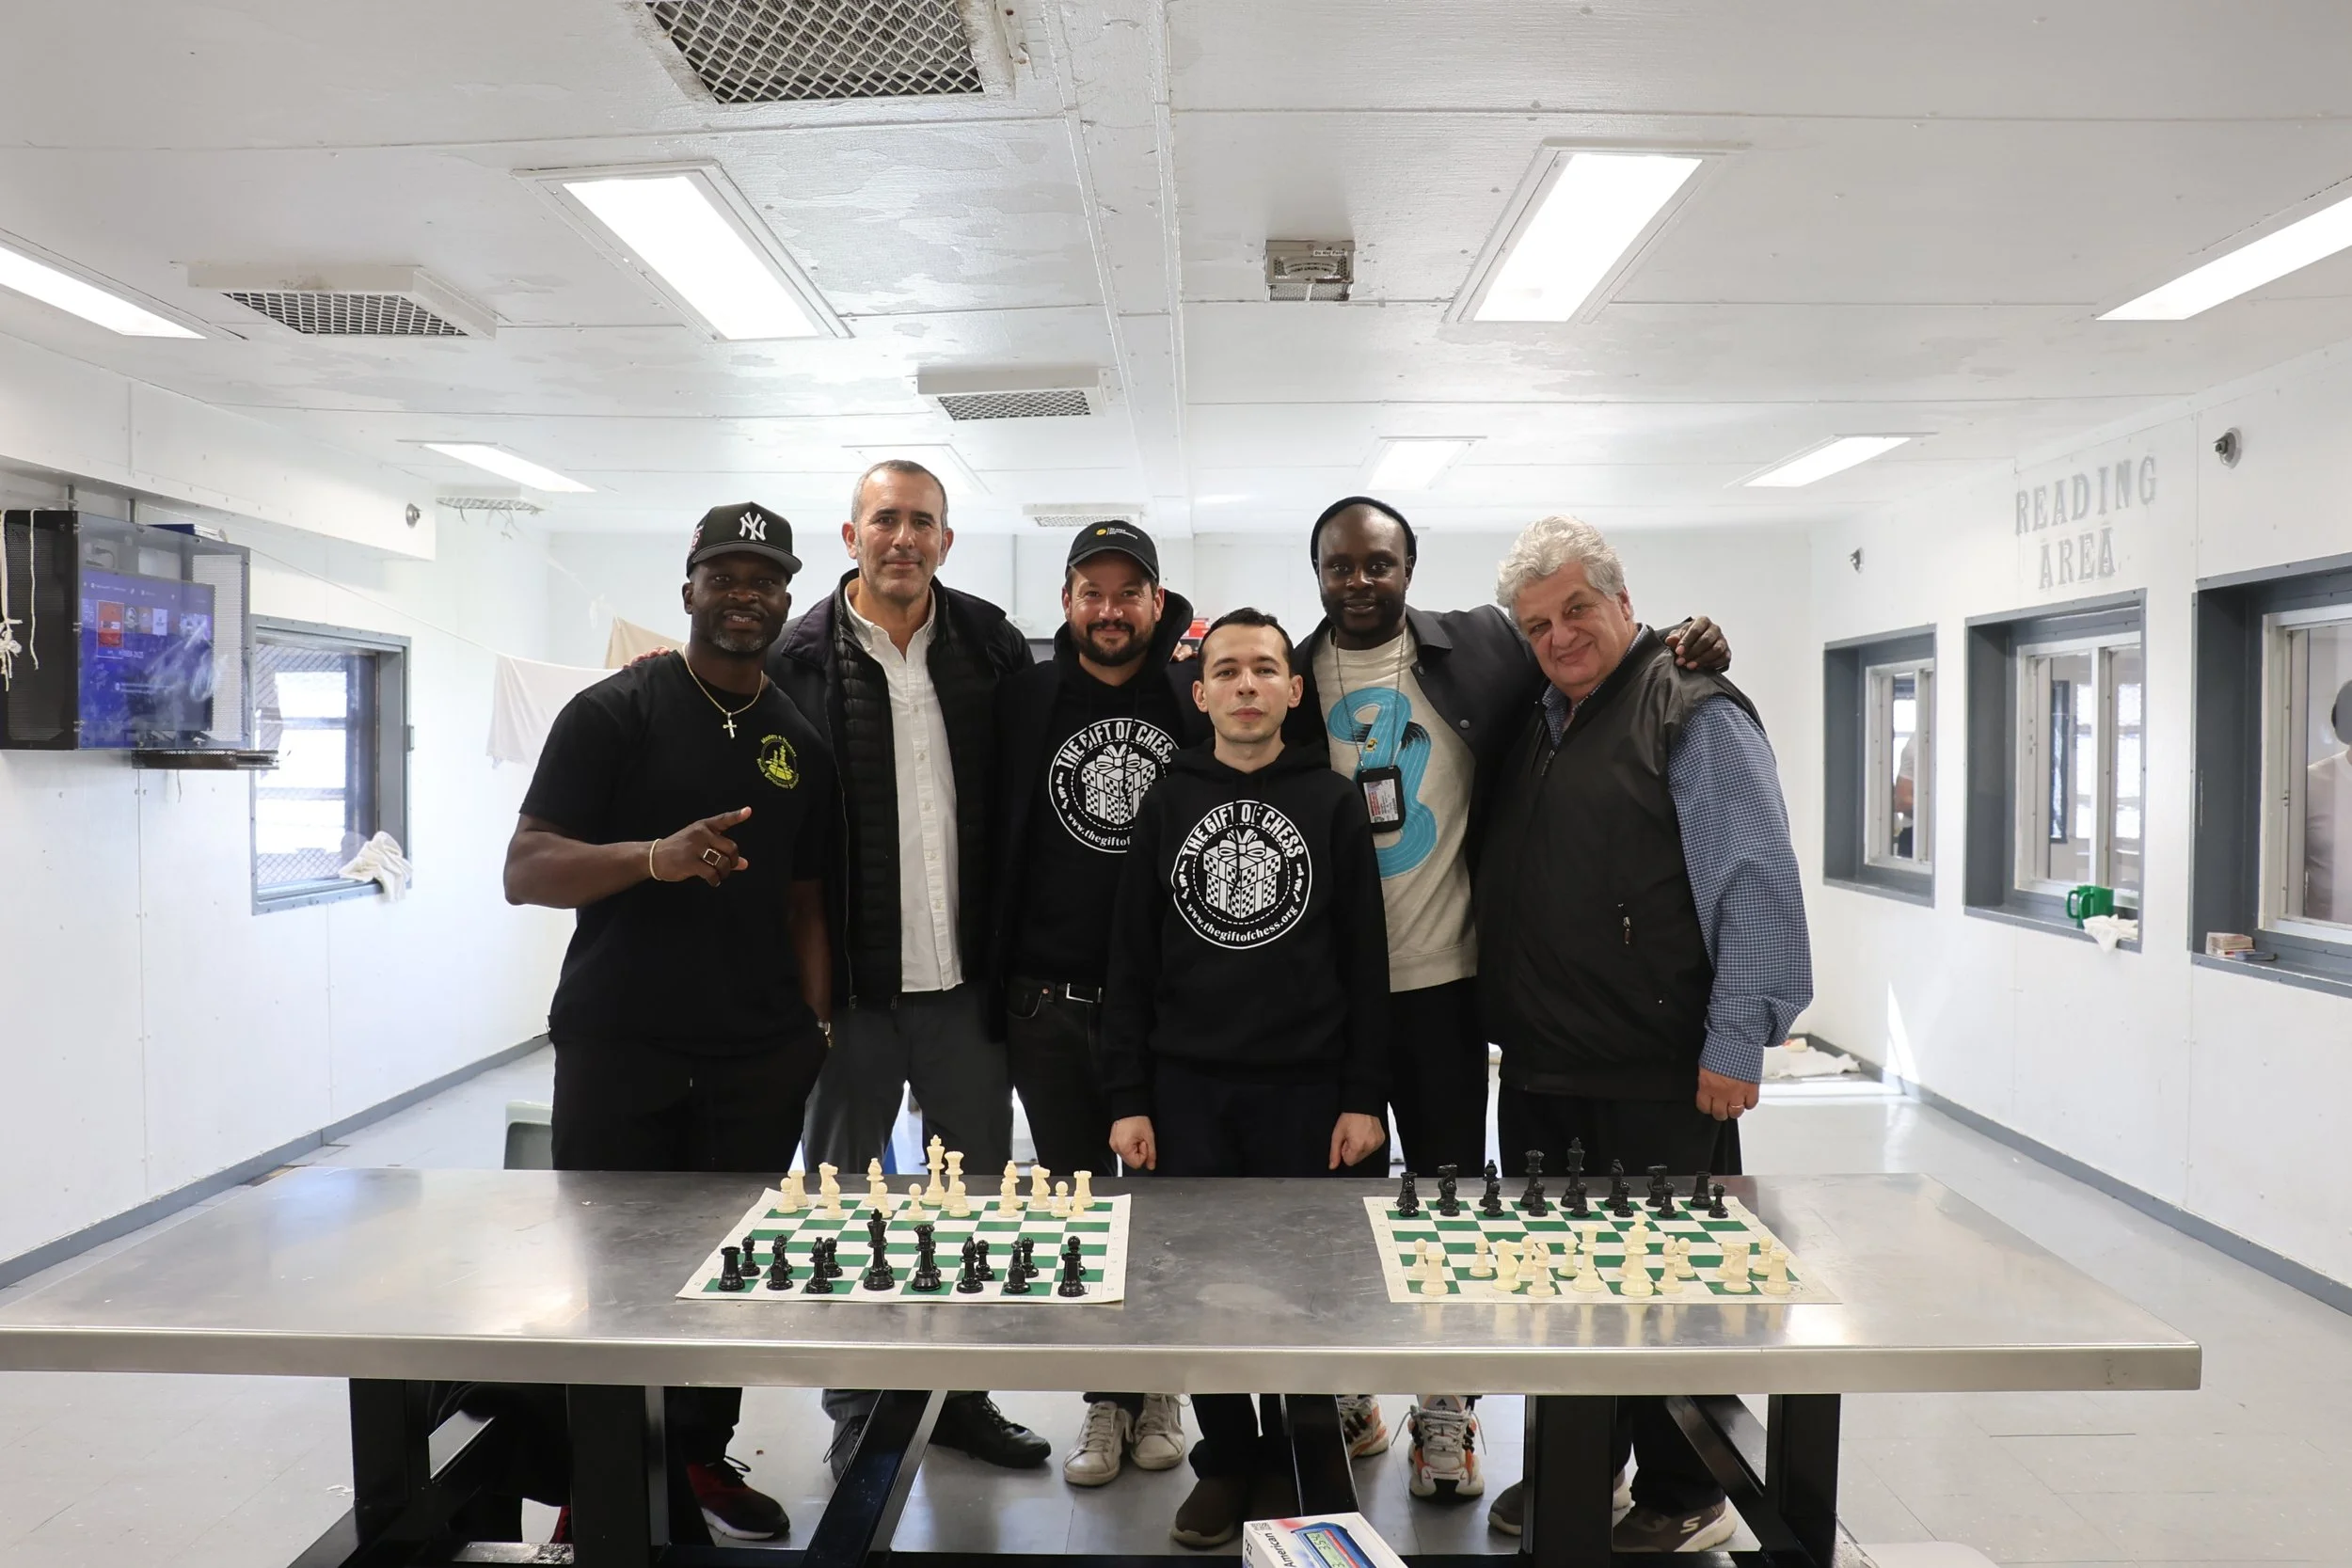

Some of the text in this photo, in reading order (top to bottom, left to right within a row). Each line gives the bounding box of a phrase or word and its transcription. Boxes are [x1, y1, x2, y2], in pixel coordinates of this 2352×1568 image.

[2015, 455, 2157, 536] READING
[739, 512, 767, 541] NY
[2039, 527, 2116, 589] AREA
[1056, 740, 1085, 768] THE
[1078, 722, 1111, 749] GIFT
[1067, 813, 1131, 847] www.thegiftof
[1182, 828, 1208, 857] THE
[1262, 811, 1305, 858] CHESS
[1186, 903, 1298, 942] www.thegiftofchess.org
[1265, 1532, 1296, 1568] American
